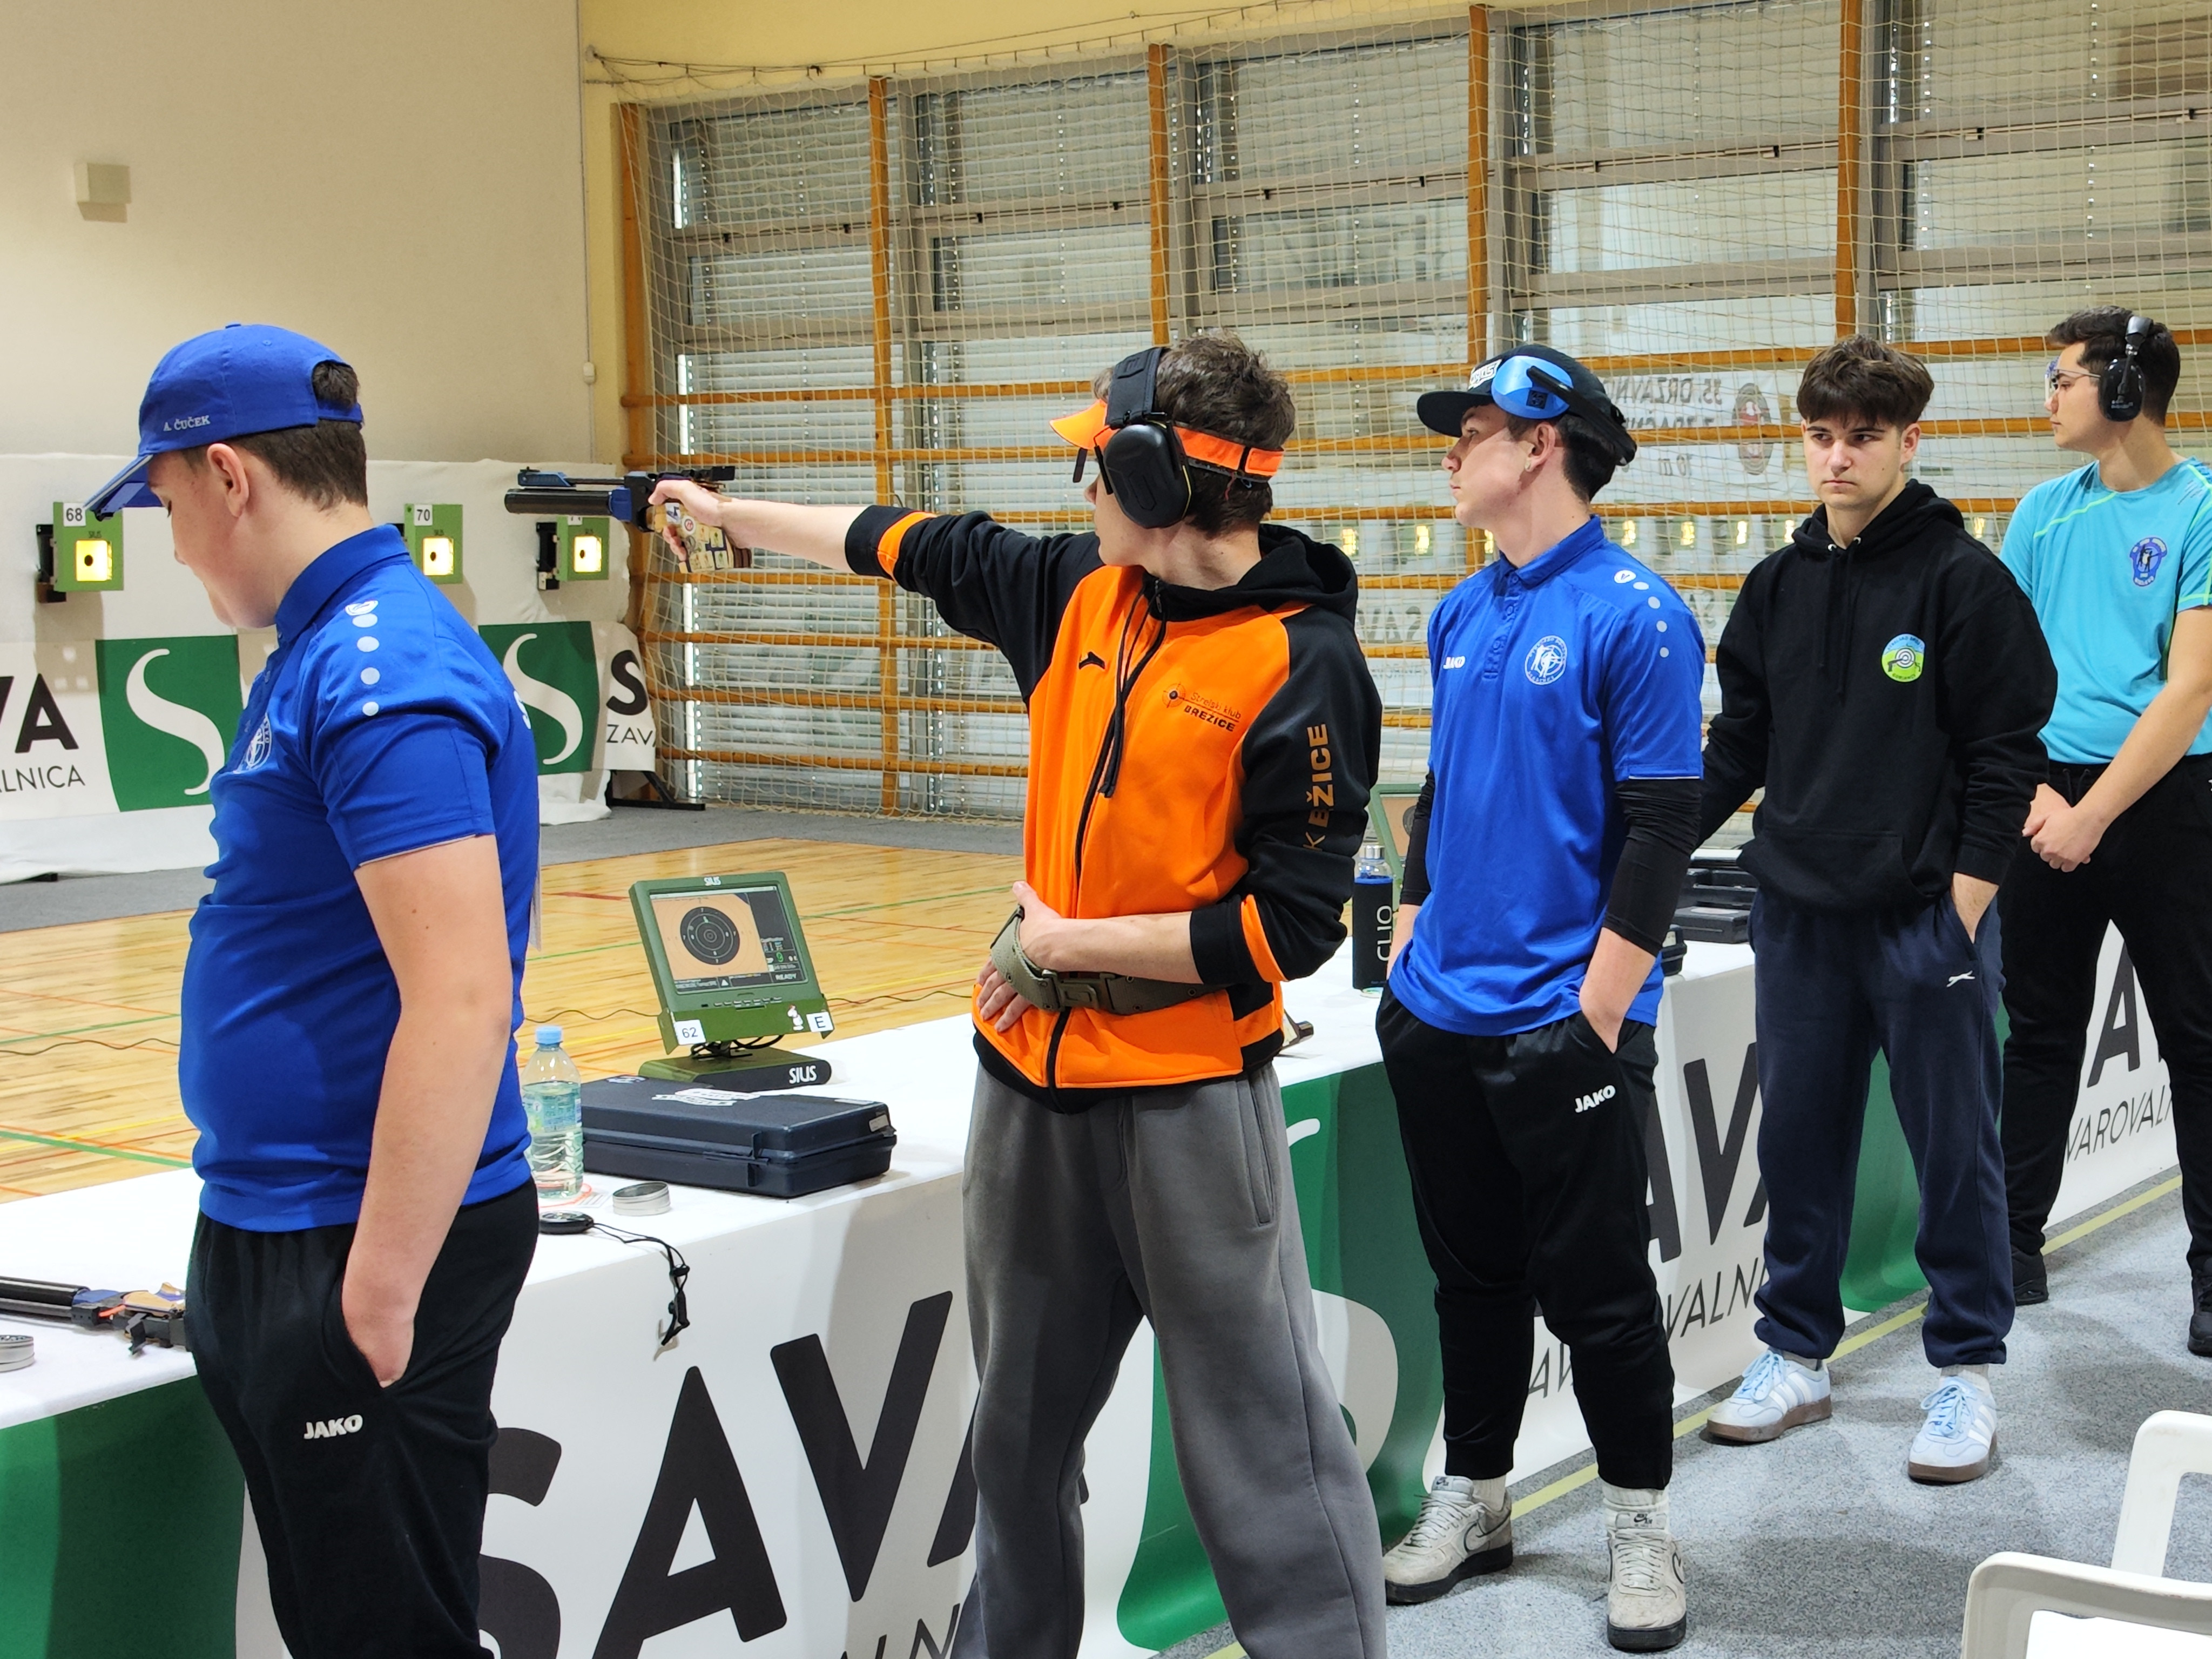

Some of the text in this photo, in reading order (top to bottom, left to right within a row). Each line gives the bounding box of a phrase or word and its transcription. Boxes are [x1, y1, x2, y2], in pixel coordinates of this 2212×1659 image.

[174, 415, 211, 430] ČUČEK
[66, 508, 83, 522] 68
[416, 509, 430, 521] 70
[1223, 705, 1242, 719] klub
[0, 765, 86, 793] LNICA
[1377, 905, 1392, 961] CLIO
[814, 1016, 826, 1028] E
[682, 1027, 698, 1038] 62
[789, 1065, 817, 1084] SIUS
[1575, 1085, 1616, 1113] JAKO
[304, 1414, 363, 1440] JAKO
